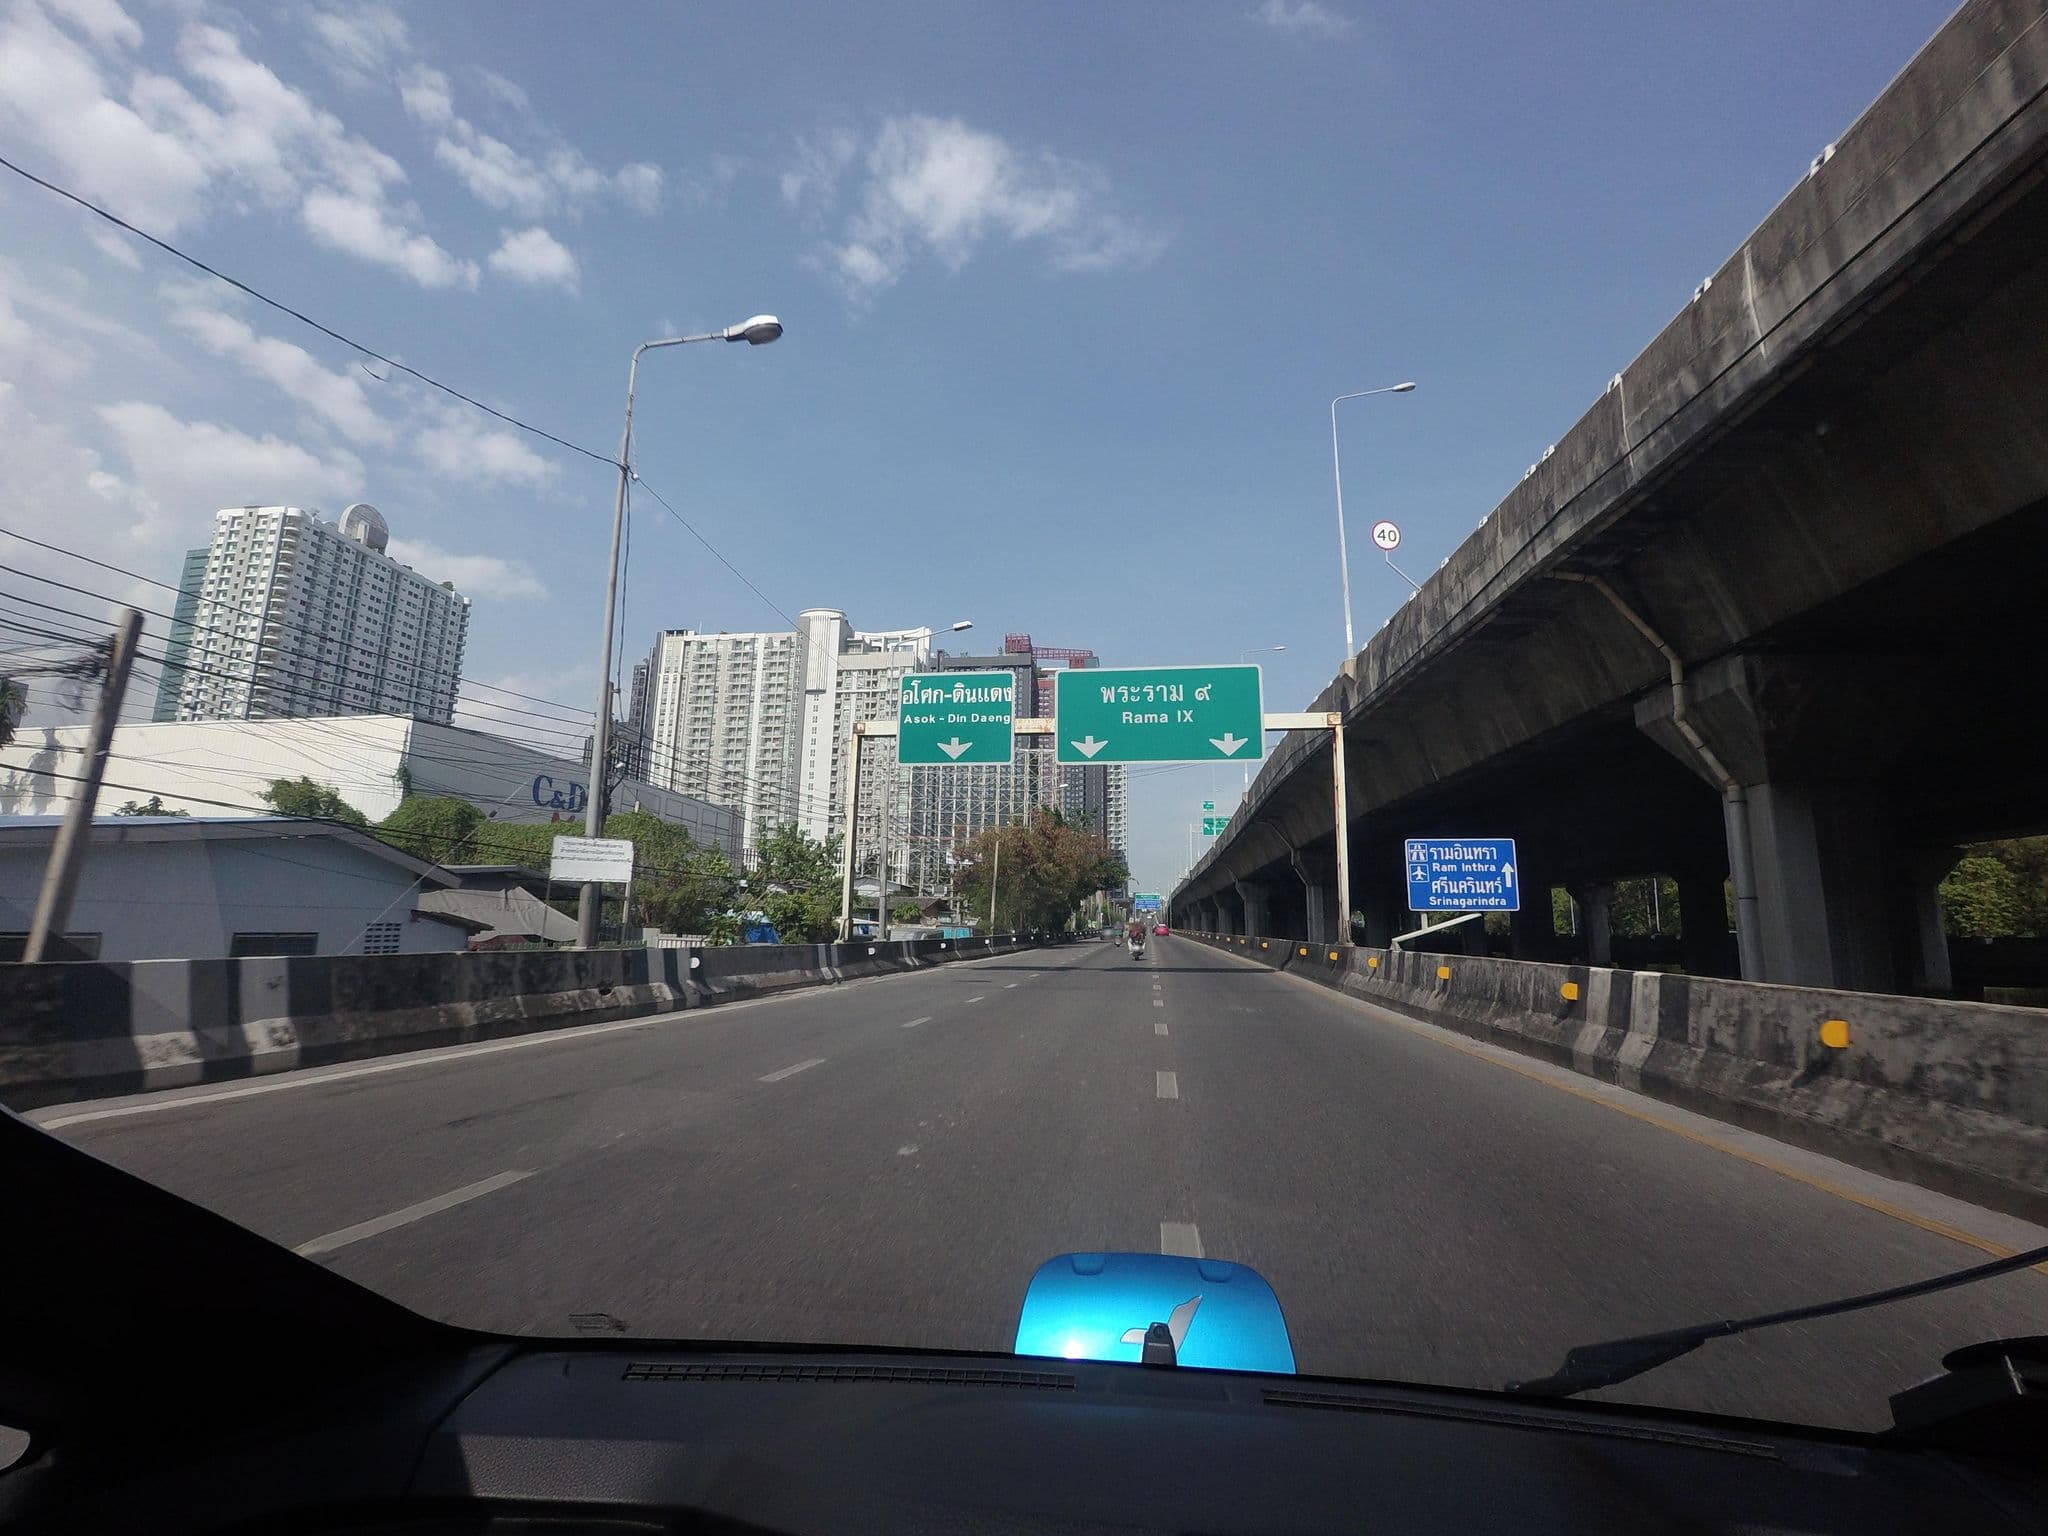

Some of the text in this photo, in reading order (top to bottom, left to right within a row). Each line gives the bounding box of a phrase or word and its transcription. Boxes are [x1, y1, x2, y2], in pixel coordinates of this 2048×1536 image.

[1377, 529, 1397, 542] 40
[902, 680, 1012, 704] อโศก-ดินแดง
[1100, 684, 1212, 703] พระราม ๙
[903, 714, 936, 724] Asok
[948, 713, 967, 723] Din
[971, 713, 1011, 725] Daeng
[1122, 710, 1194, 724] Rama IX
[532, 774, 586, 813] C&D
[1429, 844, 1498, 860] รามอินทรา
[1432, 863, 1497, 872] Ram Inthra
[1431, 876, 1504, 894] ศรีนครินทร์
[1429, 897, 1507, 908] Srinagarindra
